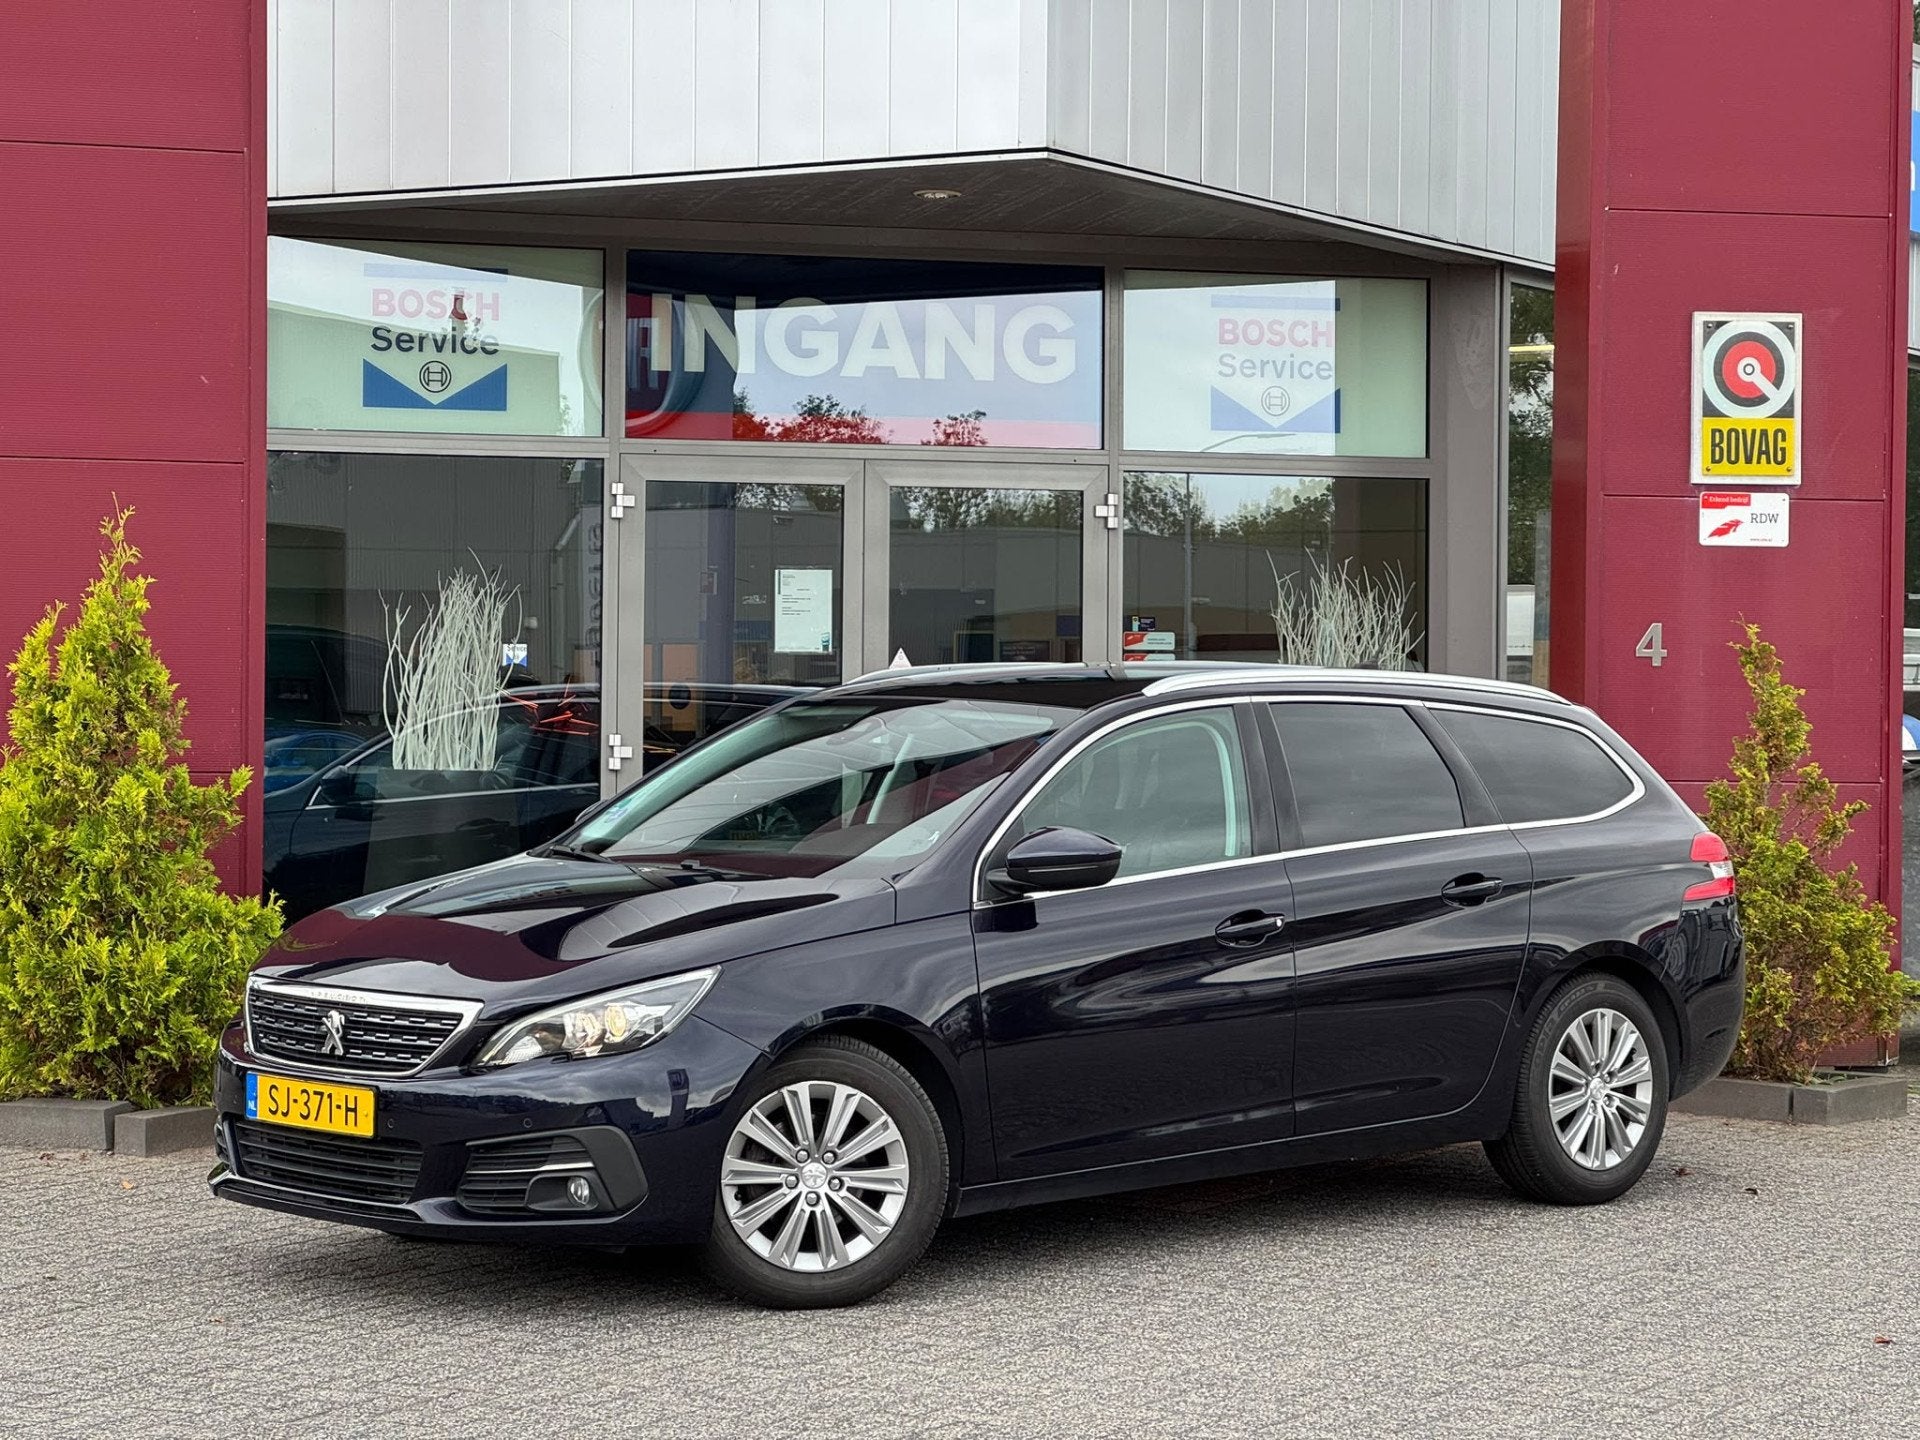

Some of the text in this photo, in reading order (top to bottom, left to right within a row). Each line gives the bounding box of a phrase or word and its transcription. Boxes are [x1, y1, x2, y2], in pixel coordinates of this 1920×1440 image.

[371, 288, 500, 321] BOSCH
[370, 325, 500, 356] Service
[650, 293, 1077, 385] INGANG
[1218, 318, 1334, 349] BOSCH
[1218, 353, 1334, 381] Service
[1710, 428, 1787, 466] BOVAG
[1750, 512, 1780, 524] RDW
[1635, 622, 1668, 667] 4
[268, 1084, 358, 1127] SJ-371-H
